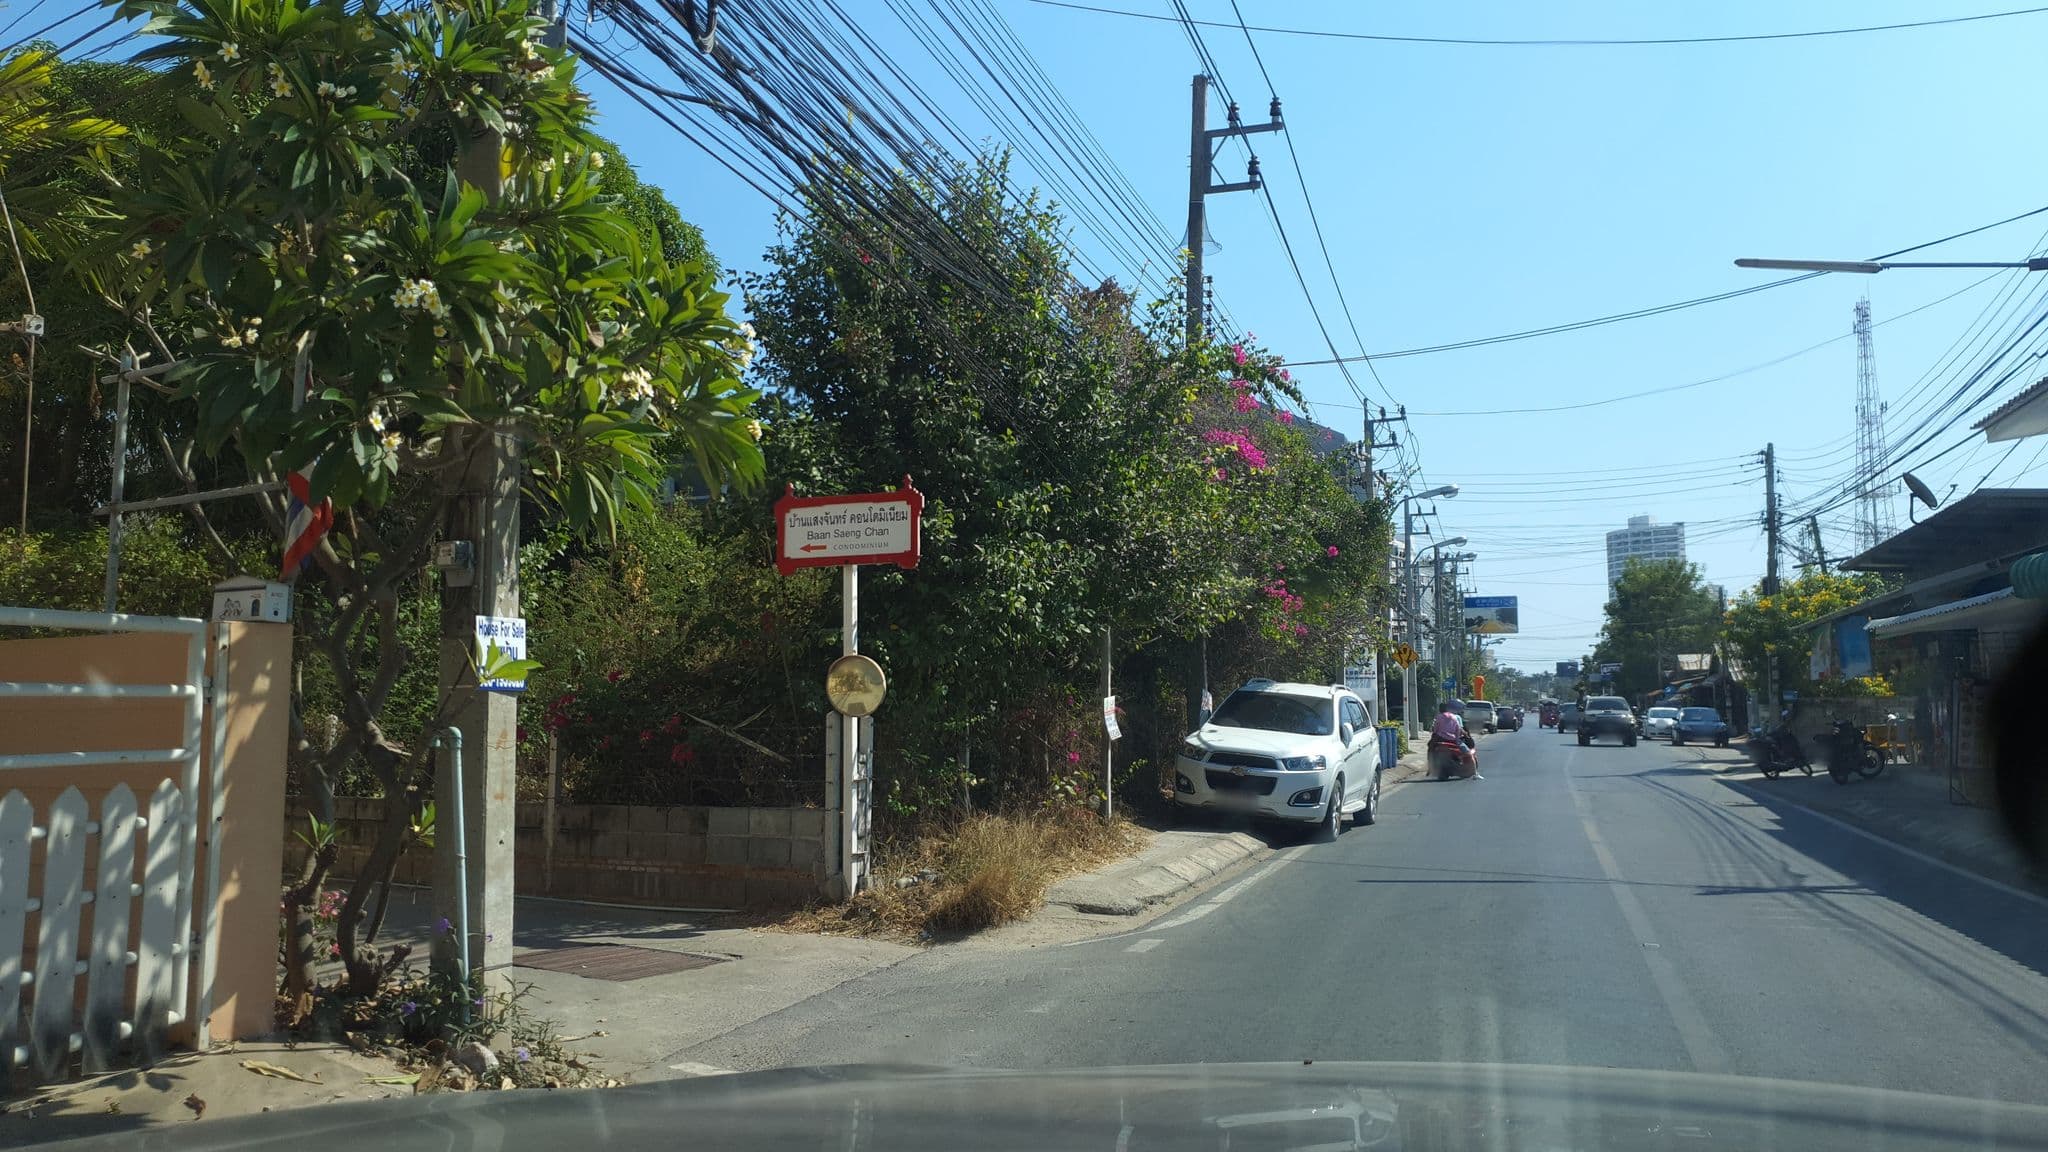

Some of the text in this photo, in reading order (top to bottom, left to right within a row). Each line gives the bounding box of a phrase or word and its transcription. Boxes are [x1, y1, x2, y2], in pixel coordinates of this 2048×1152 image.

[789, 506, 908, 528] บ้านแสงจันทร์ คอนโดมิเนียม
[807, 527, 889, 540] Baan Saeng Chan
[833, 542, 889, 550] CONDOMINIUM
[478, 619, 524, 638] House For Sale
